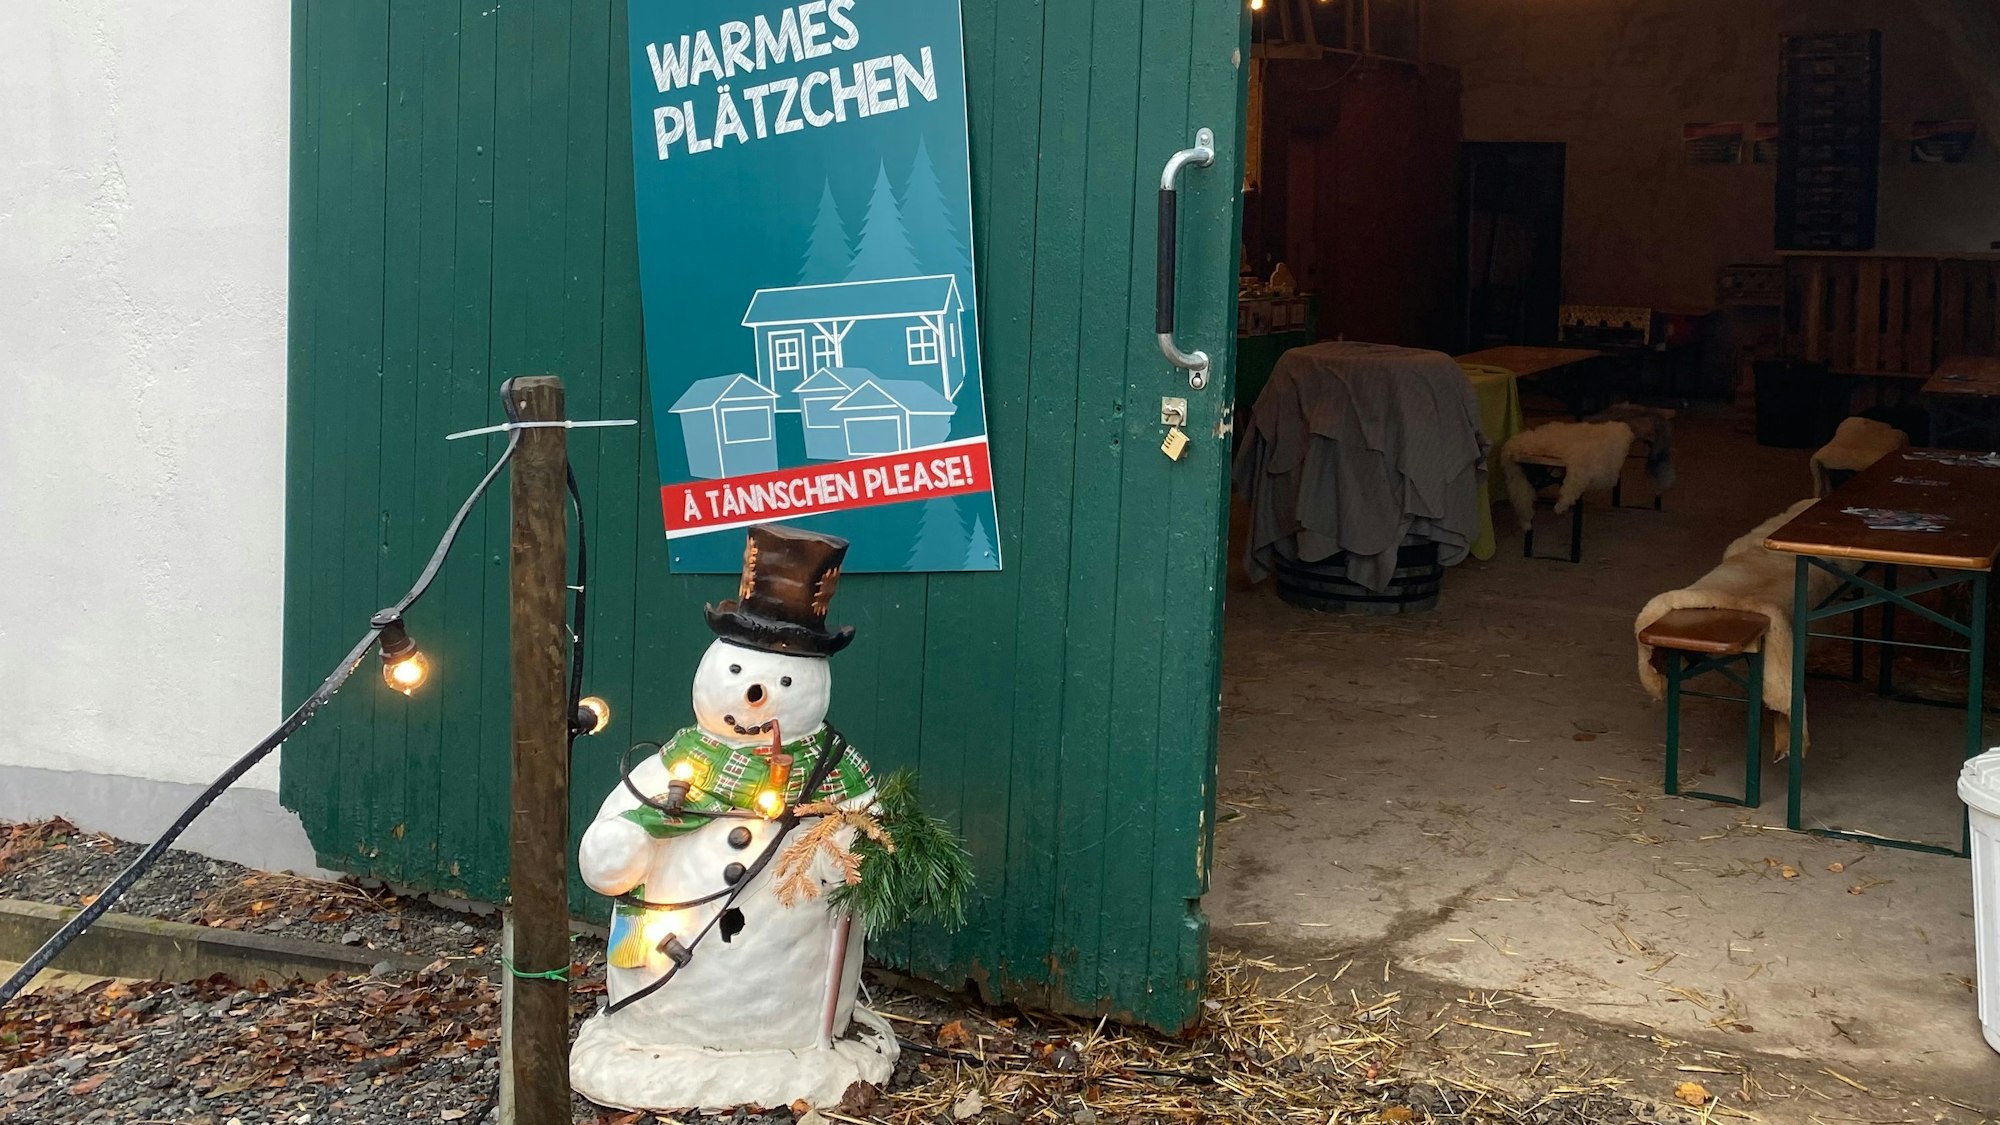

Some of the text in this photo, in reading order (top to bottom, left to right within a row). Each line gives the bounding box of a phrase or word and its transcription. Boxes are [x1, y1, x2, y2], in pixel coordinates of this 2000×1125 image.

[646, 0, 859, 92] WARMES
[653, 46, 937, 160] PLÄTZCHEN
[683, 455, 974, 522] Ä TÄNNSCHEN PLEASE!
